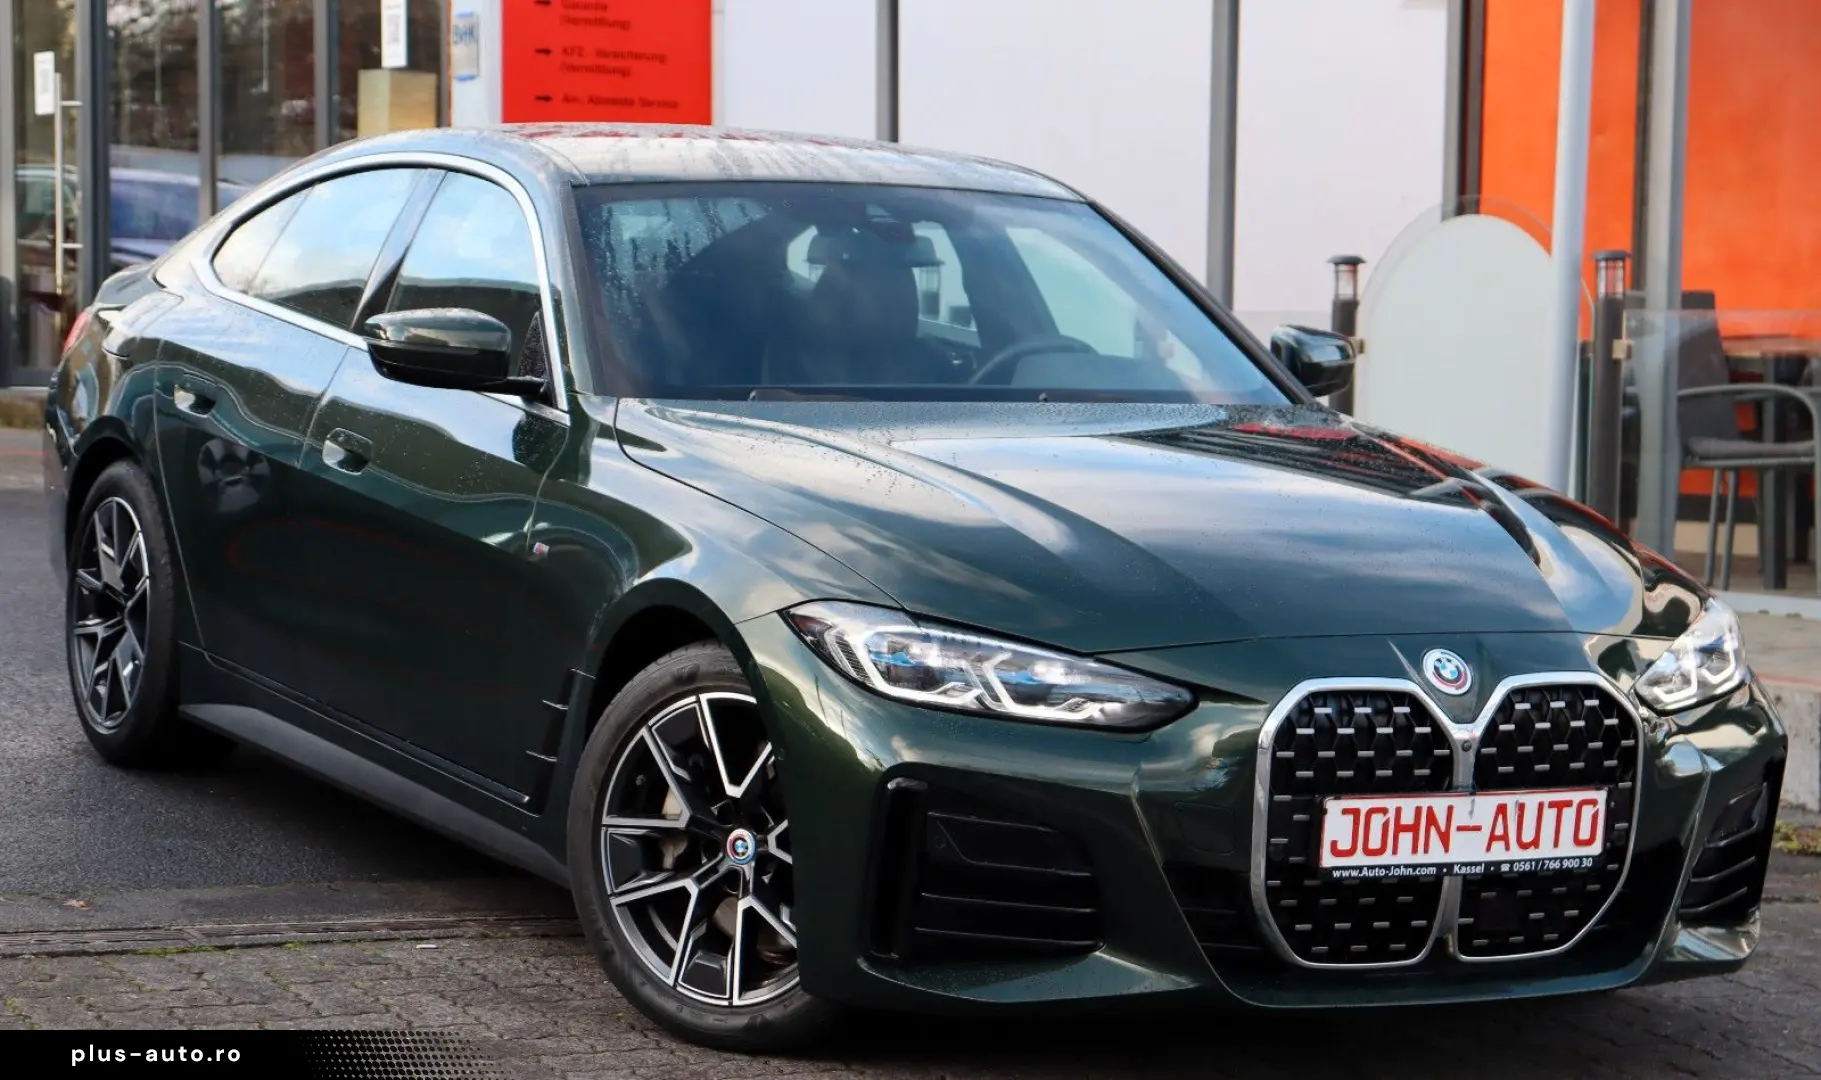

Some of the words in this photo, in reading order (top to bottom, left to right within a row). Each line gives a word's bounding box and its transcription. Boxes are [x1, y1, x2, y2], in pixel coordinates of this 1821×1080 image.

[1330, 799, 1599, 857] JOHN-AUTO
[1332, 865, 1437, 878] www.Auto-John.com
[1453, 863, 1485, 874] Kassel
[1513, 861, 1536, 872] 0561
[1543, 860, 1561, 870] 766
[1562, 858, 1581, 869] 900
[1581, 857, 1593, 868] 30
